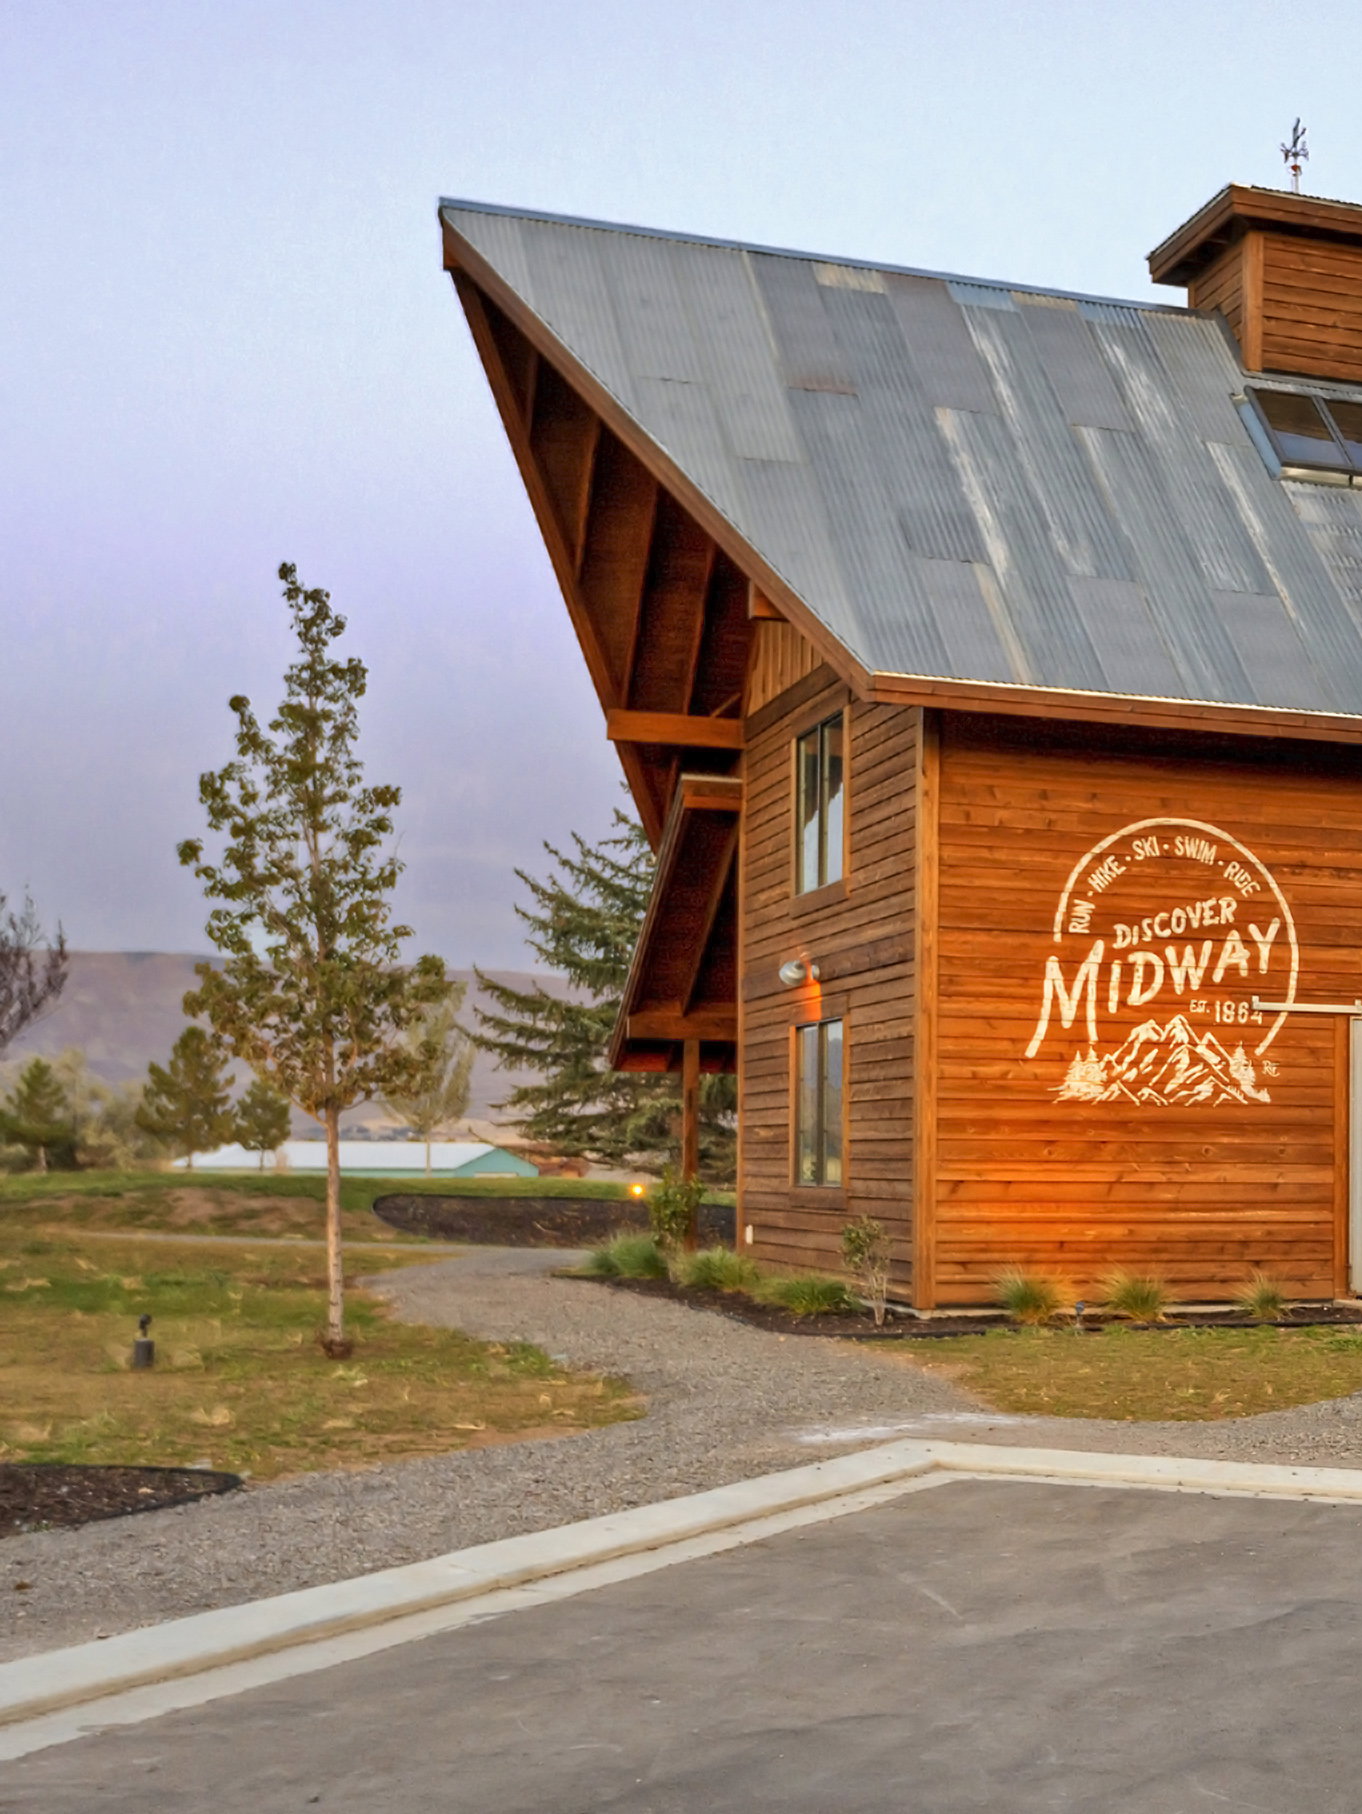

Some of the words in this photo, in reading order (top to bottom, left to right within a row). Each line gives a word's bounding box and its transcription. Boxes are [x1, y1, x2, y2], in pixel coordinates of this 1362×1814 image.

[1069, 899, 1096, 934] RUN
[1087, 855, 1127, 893] HIKE
[1132, 836, 1160, 861] SKI
[1174, 836, 1217, 866] SWIM
[1223, 861, 1261, 898] RIDE
[1112, 897, 1238, 949] DISCOVER
[1024, 917, 1281, 1058] MIDWAY
